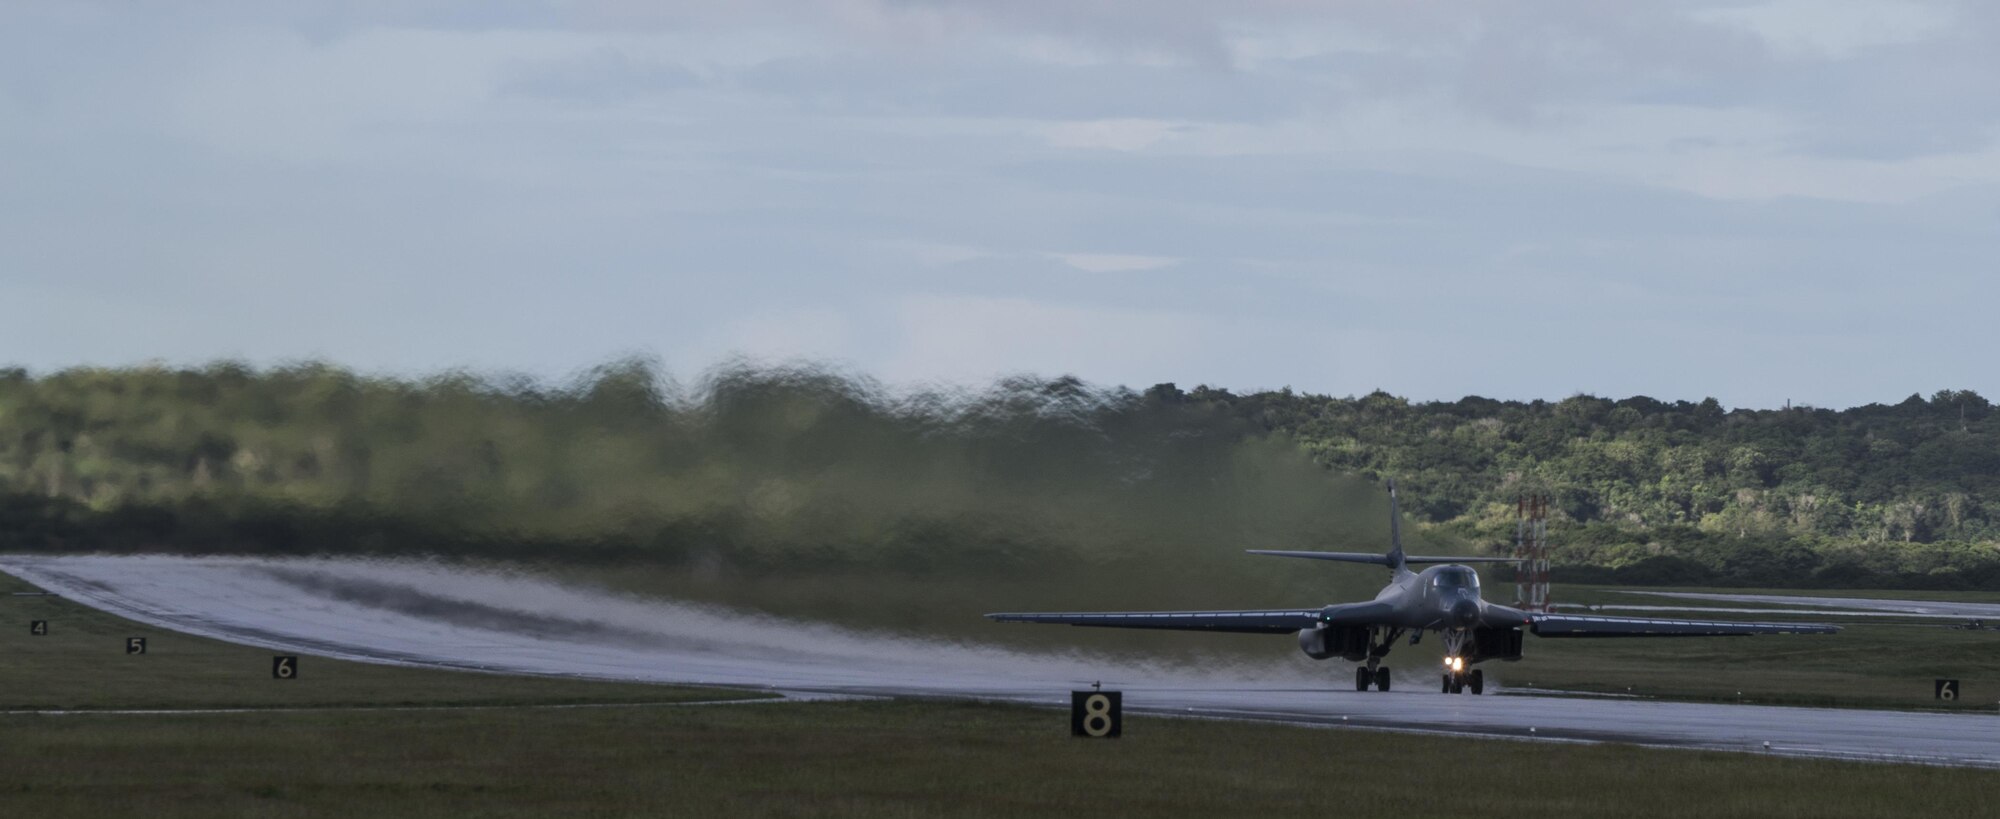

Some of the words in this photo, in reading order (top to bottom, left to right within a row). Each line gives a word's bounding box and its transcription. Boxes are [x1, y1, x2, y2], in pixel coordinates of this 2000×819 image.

[34, 622, 44, 635] 4
[131, 639, 142, 654] 5
[278, 658, 291, 677] 6
[1940, 682, 1954, 700] 6
[1084, 694, 1111, 736] 8
